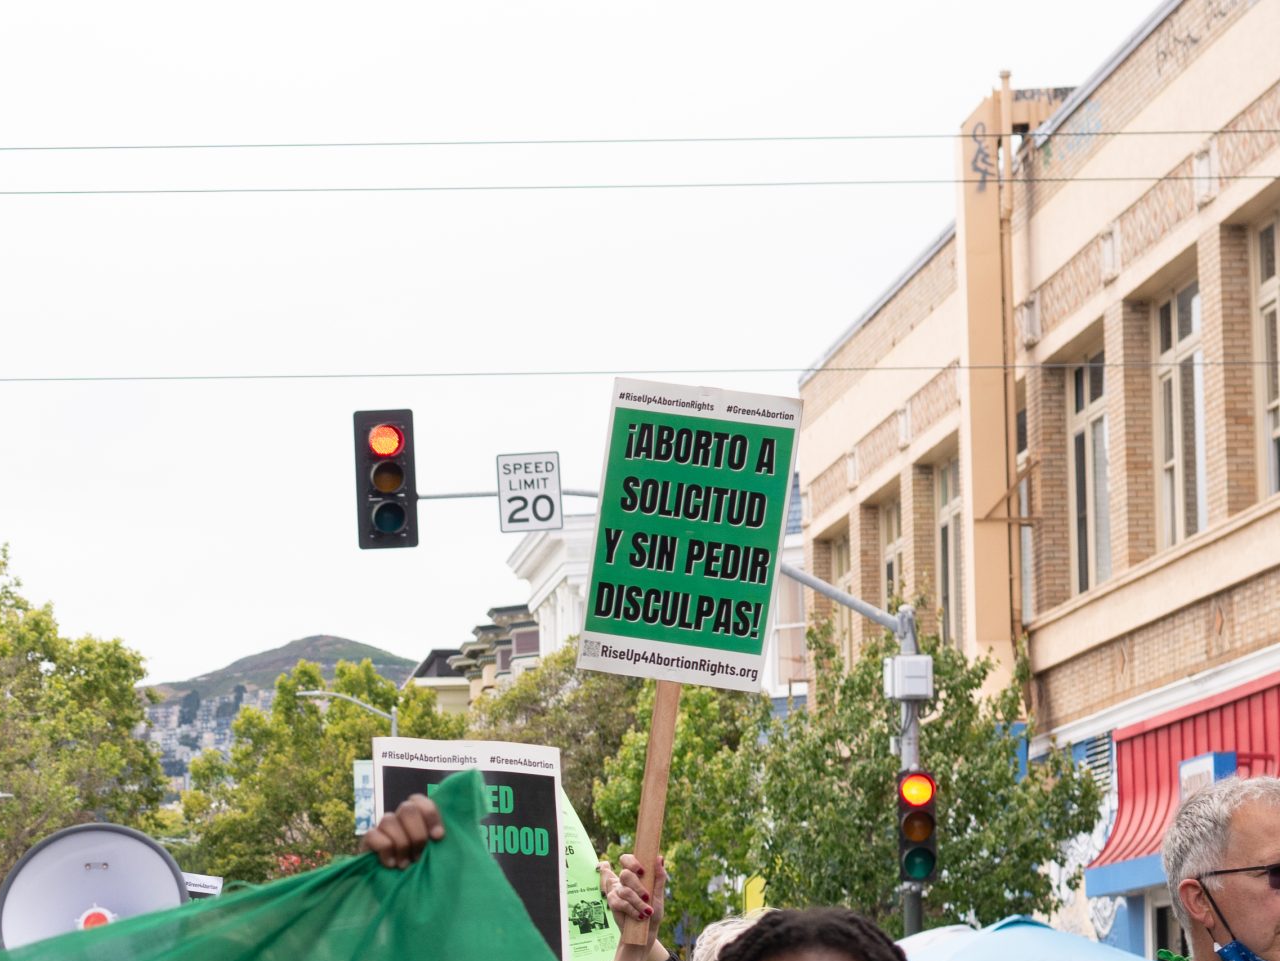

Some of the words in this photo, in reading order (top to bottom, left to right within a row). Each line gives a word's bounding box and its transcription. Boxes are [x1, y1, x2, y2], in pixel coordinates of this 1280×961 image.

[619, 391, 715, 412] #RiseUp4AbortionRights
[726, 404, 795, 421] #Green4Abortion
[502, 461, 555, 476] SPEED
[756, 437, 777, 476] A
[508, 478, 549, 492] LIMIT
[507, 494, 555, 524] 20
[620, 476, 767, 529] SOLICITUD
[604, 528, 623, 565] Y
[629, 531, 678, 573] SIN
[685, 539, 770, 585] PEDIR
[593, 581, 764, 640] DISCULPAS!
[600, 645, 758, 682] RiseUp4AbortionRights.org
[381, 751, 477, 766] #RiseUp4AbortionRights
[489, 755, 554, 769] #Green4Abortion
